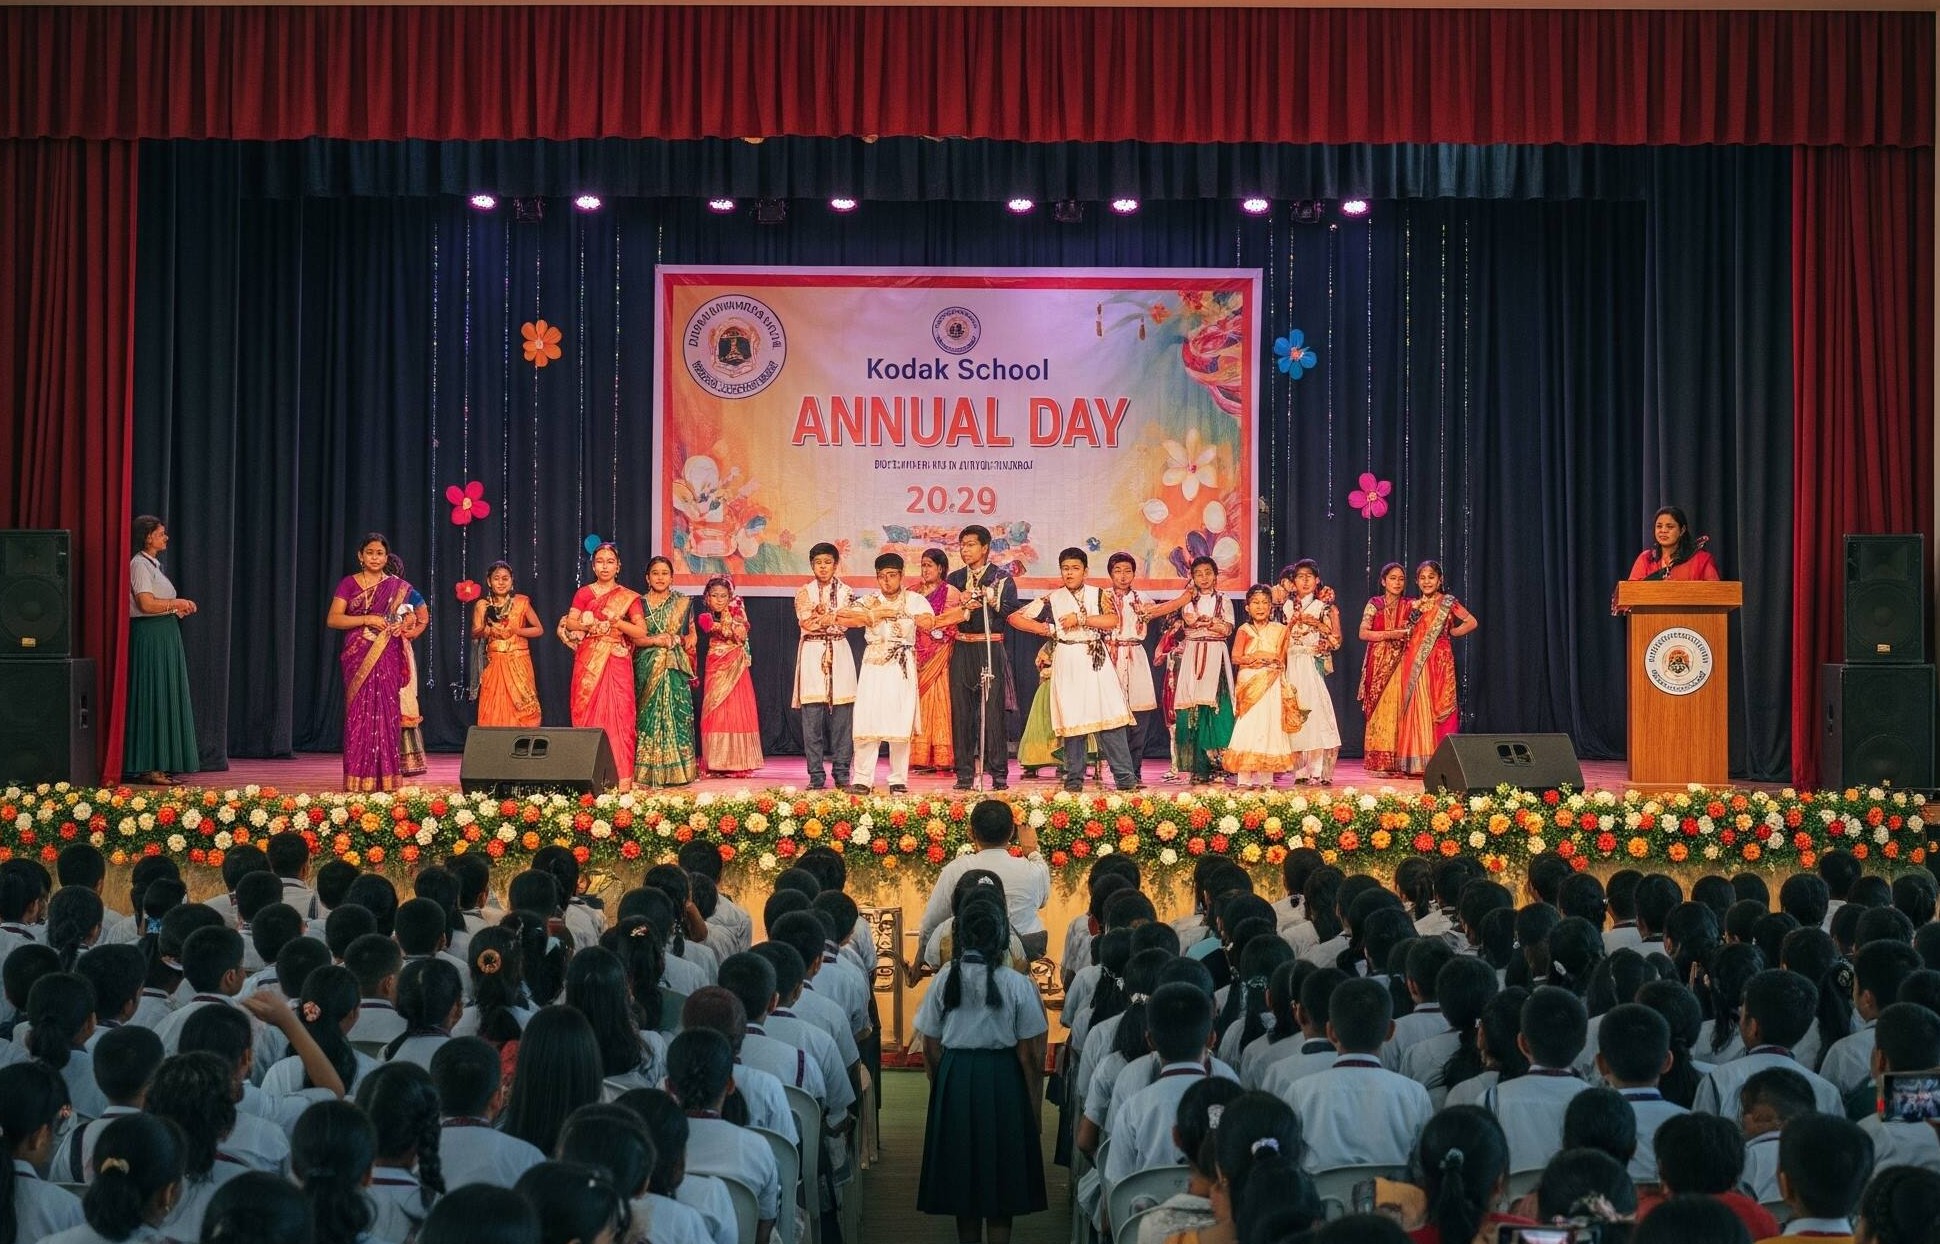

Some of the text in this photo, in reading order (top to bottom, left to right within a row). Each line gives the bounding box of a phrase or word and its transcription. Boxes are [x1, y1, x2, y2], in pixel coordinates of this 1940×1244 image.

[867, 357, 1049, 381] Kodak School
[791, 395, 1131, 448] ANNUAL DAY
